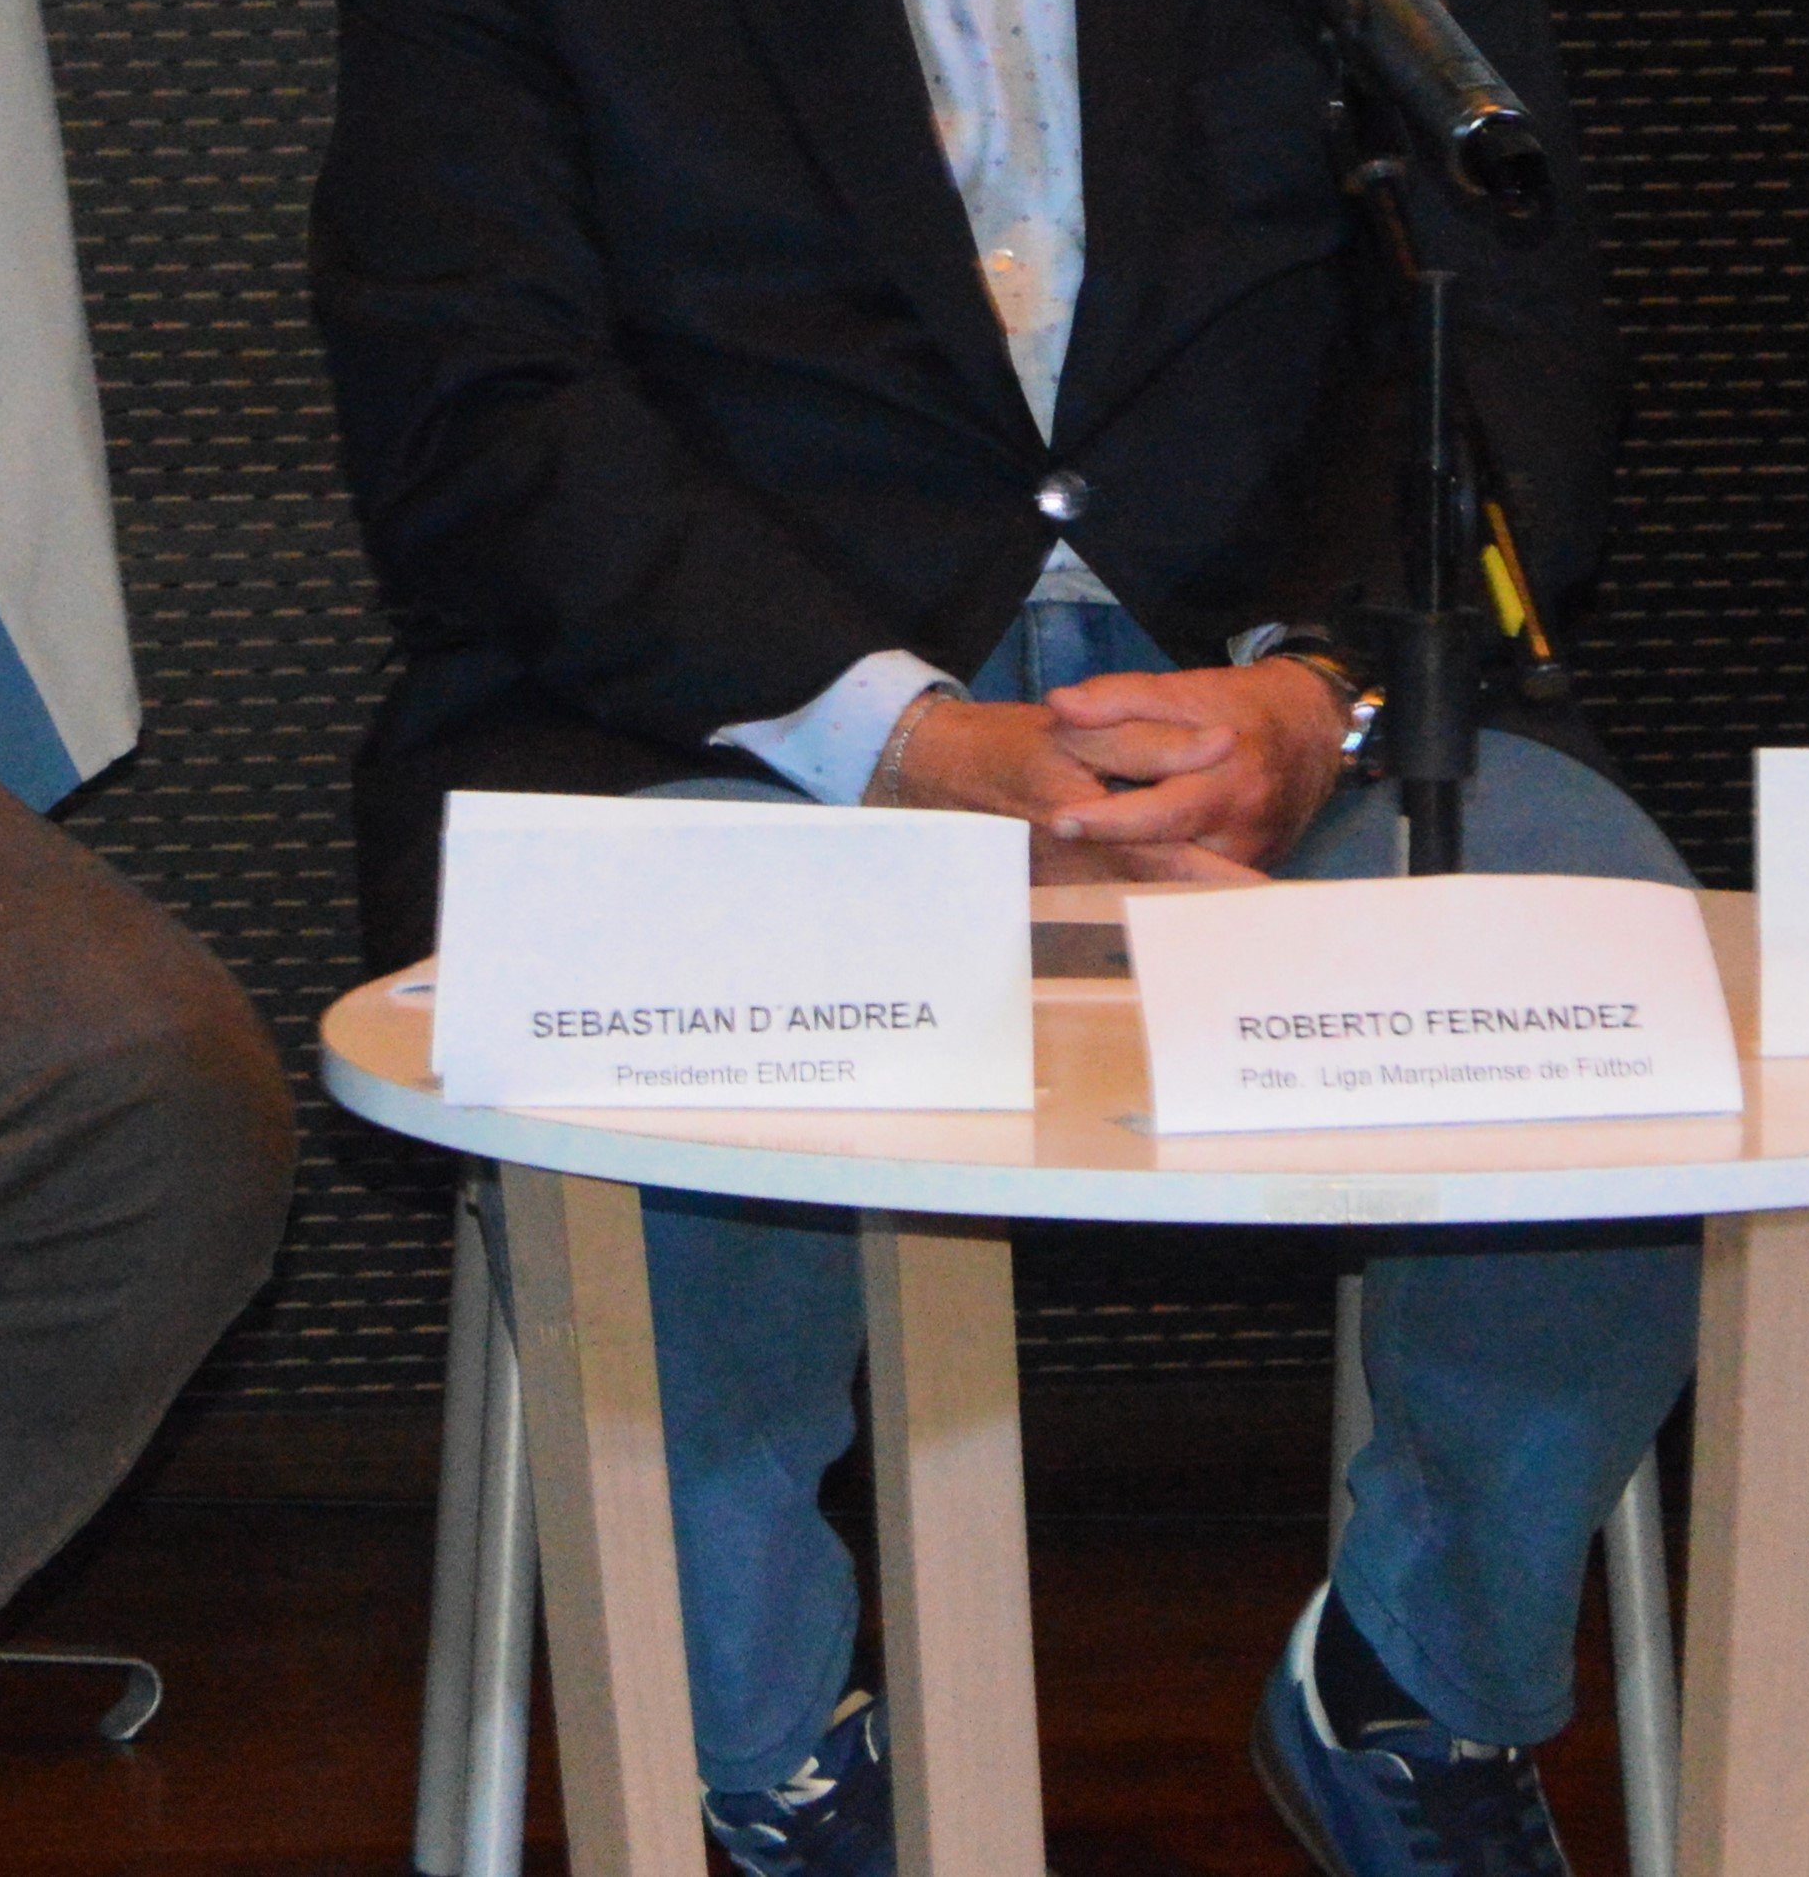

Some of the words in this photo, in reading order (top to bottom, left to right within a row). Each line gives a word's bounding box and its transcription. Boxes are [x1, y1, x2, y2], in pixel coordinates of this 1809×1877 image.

[531, 1005, 736, 1039] SEBASTIAN
[1238, 1010, 1414, 1041] ROBERTO
[1425, 1003, 1642, 1036] FERNANDEZ
[616, 1062, 748, 1088] Presidente
[757, 1058, 856, 1085] EMDER
[1240, 1066, 1305, 1091] Pdte.
[1320, 1063, 1372, 1092] Liga
[1381, 1059, 1531, 1090] Marplatense
[1539, 1059, 1569, 1081] de
